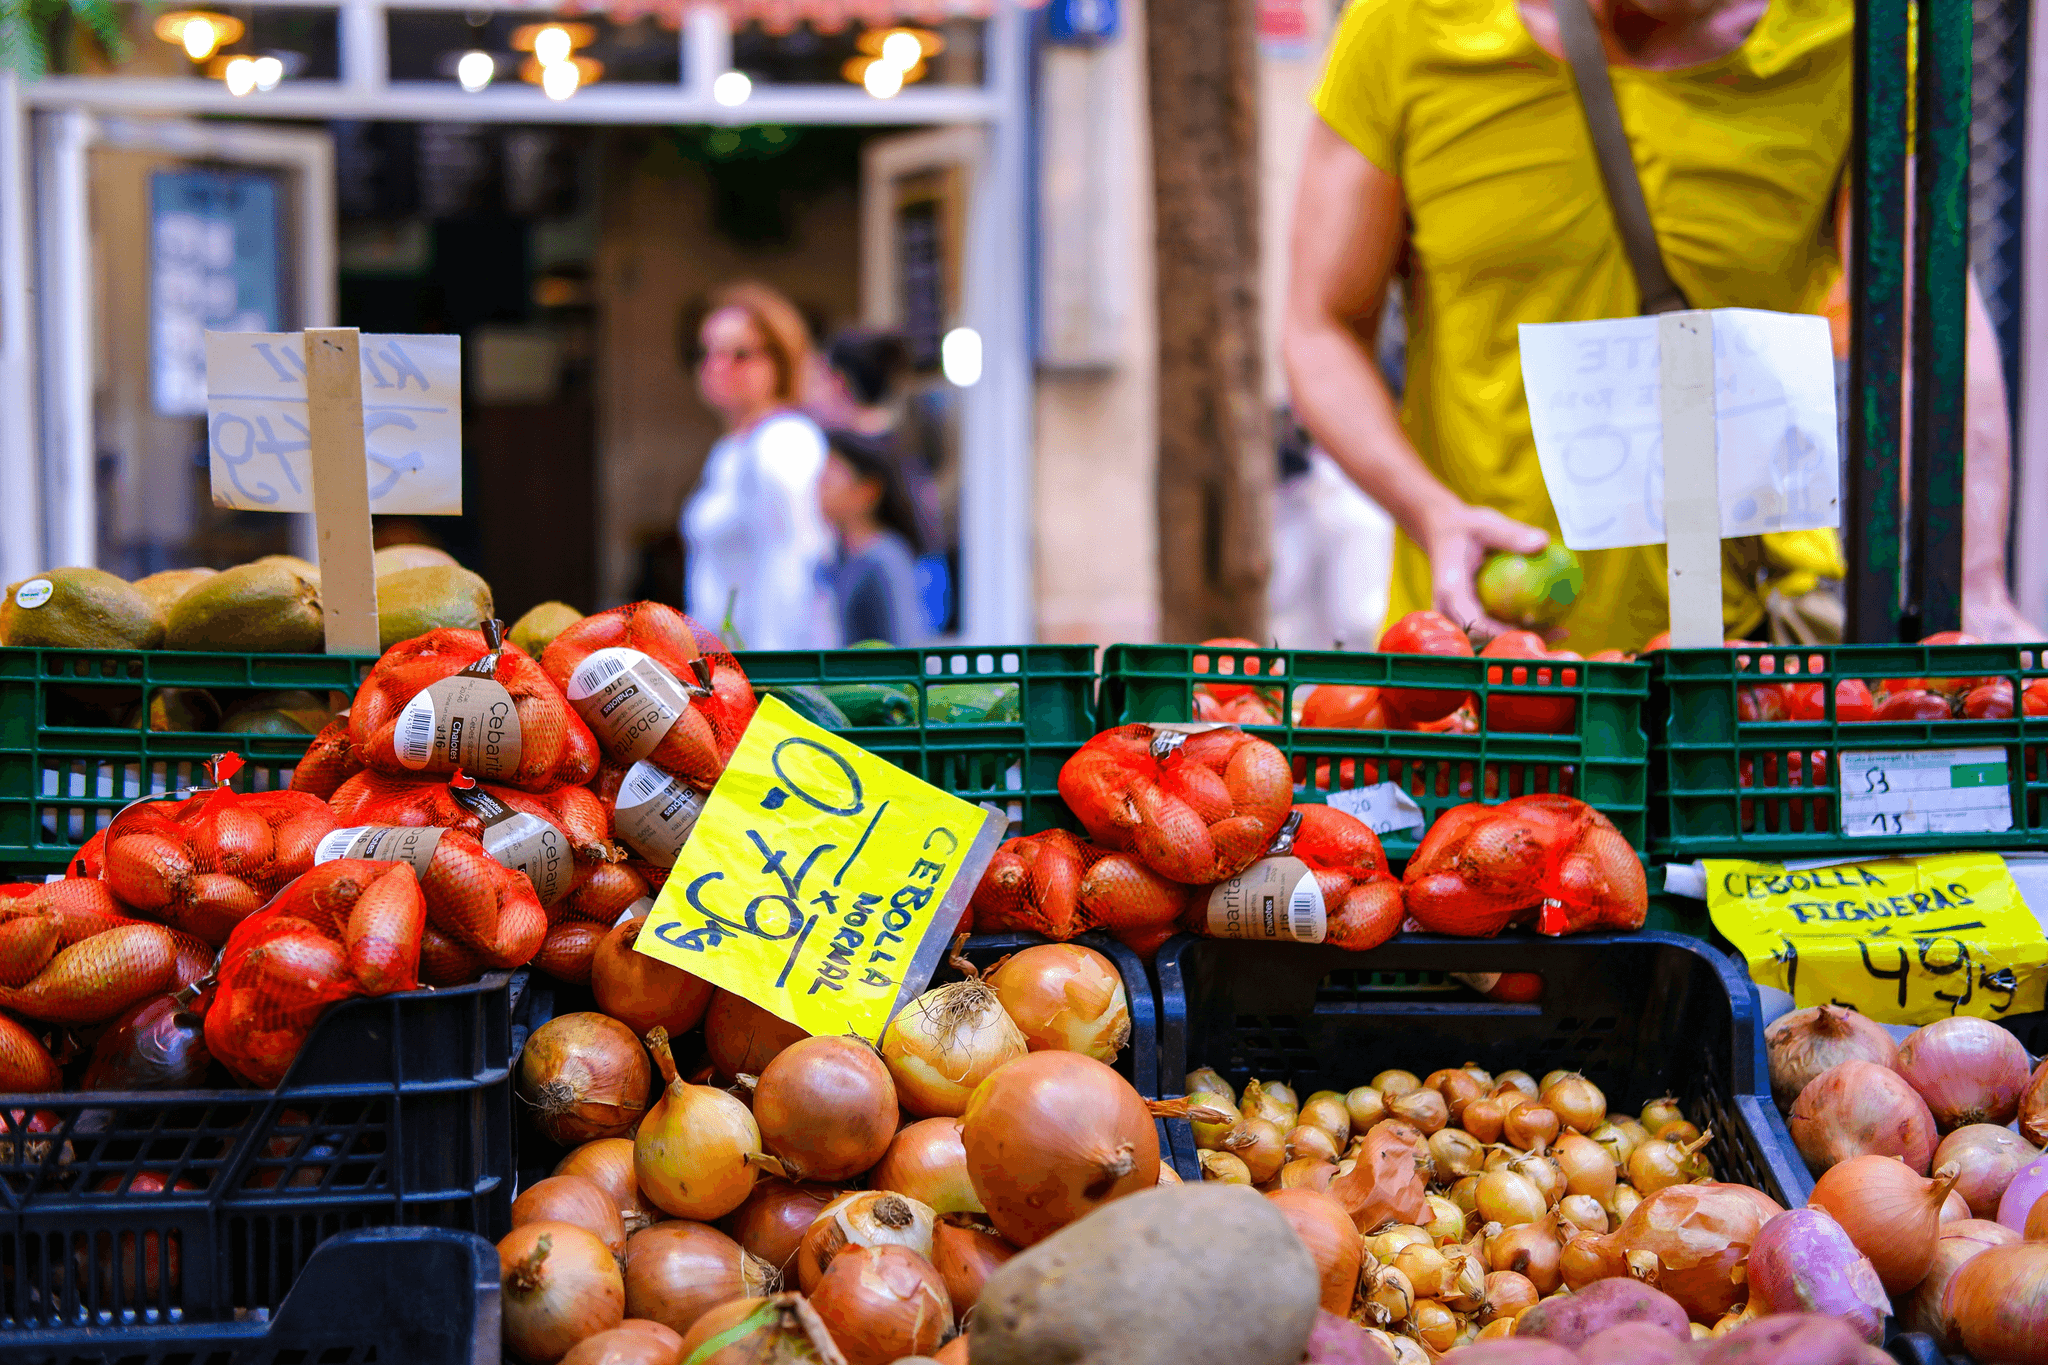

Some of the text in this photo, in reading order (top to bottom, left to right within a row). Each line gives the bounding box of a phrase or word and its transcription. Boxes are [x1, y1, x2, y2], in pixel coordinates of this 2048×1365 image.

[604, 687, 634, 714] Chalotes
[450, 721, 462, 760] Chalotes
[542, 830, 560, 907] Cebarita
[1723, 866, 1888, 899] CEBOLLA
[858, 827, 959, 988] CEBOLLA
[1788, 883, 1976, 925] FIGUERAS
[807, 892, 884, 996] NORMAL
